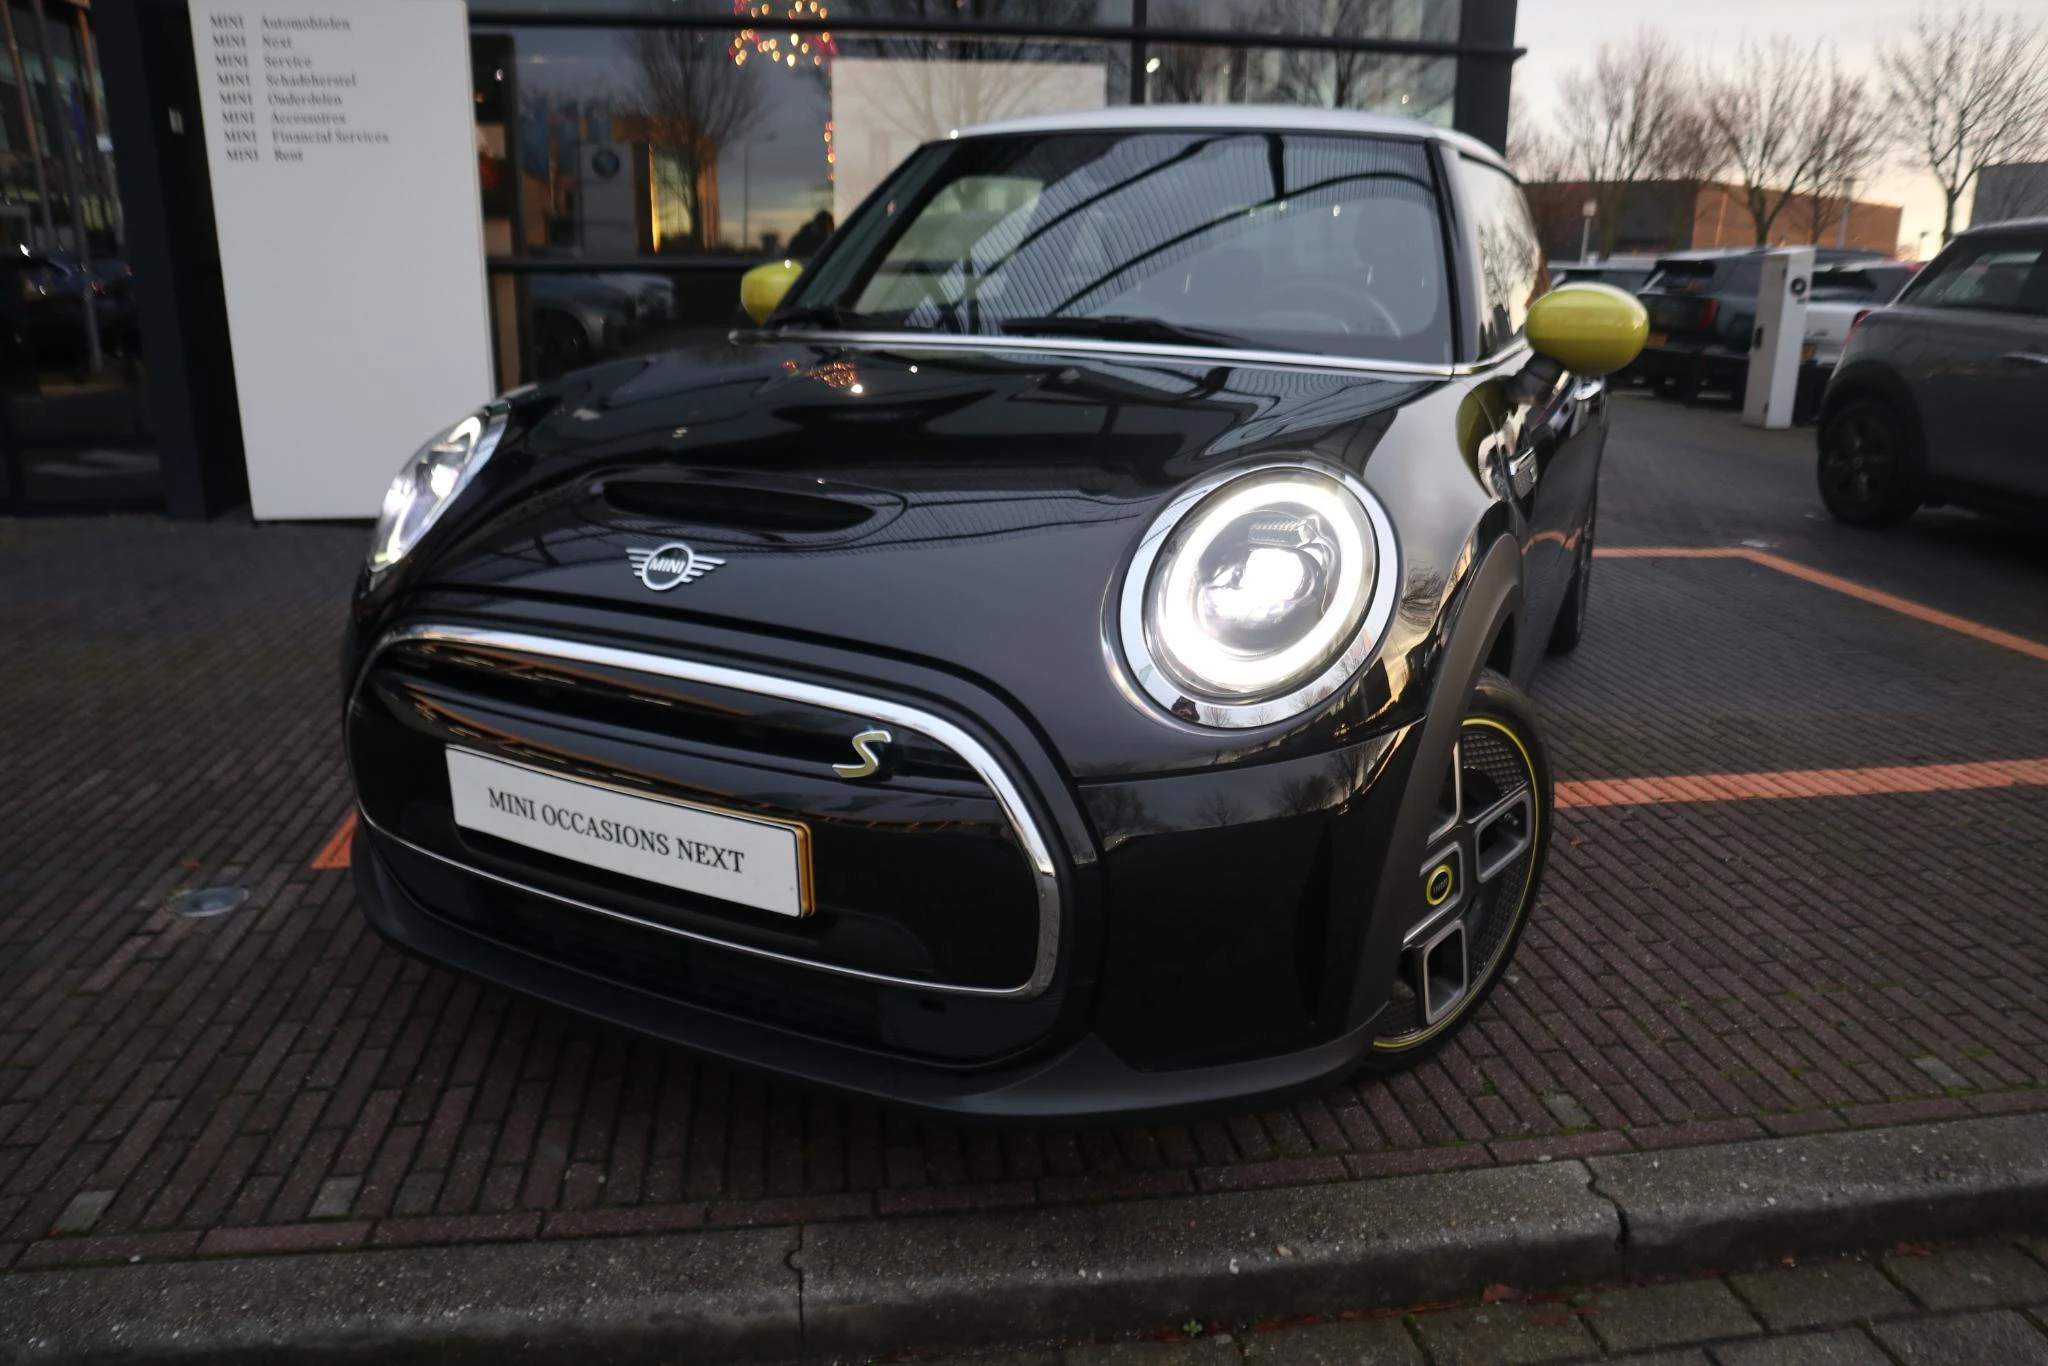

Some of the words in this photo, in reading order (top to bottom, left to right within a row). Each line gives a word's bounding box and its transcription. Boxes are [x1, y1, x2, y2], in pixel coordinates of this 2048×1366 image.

[209, 15, 244, 28] MINI
[212, 35, 246, 47] MINI
[262, 35, 292, 48] Next
[215, 55, 248, 66] MINI
[264, 55, 312, 68] Service
[217, 73, 250, 85] MINI
[219, 93, 252, 105] MINI
[222, 111, 254, 123] MINI
[224, 131, 257, 142] MINI
[272, 130, 332, 143] Financial
[226, 149, 259, 161] MINI
[274, 149, 303, 162] Rent
[648, 558, 686, 574] MINI
[832, 730, 892, 778] S
[487, 787, 537, 821] MINI
[542, 803, 670, 855] OCCASIONS
[676, 838, 745, 873] NEXT
